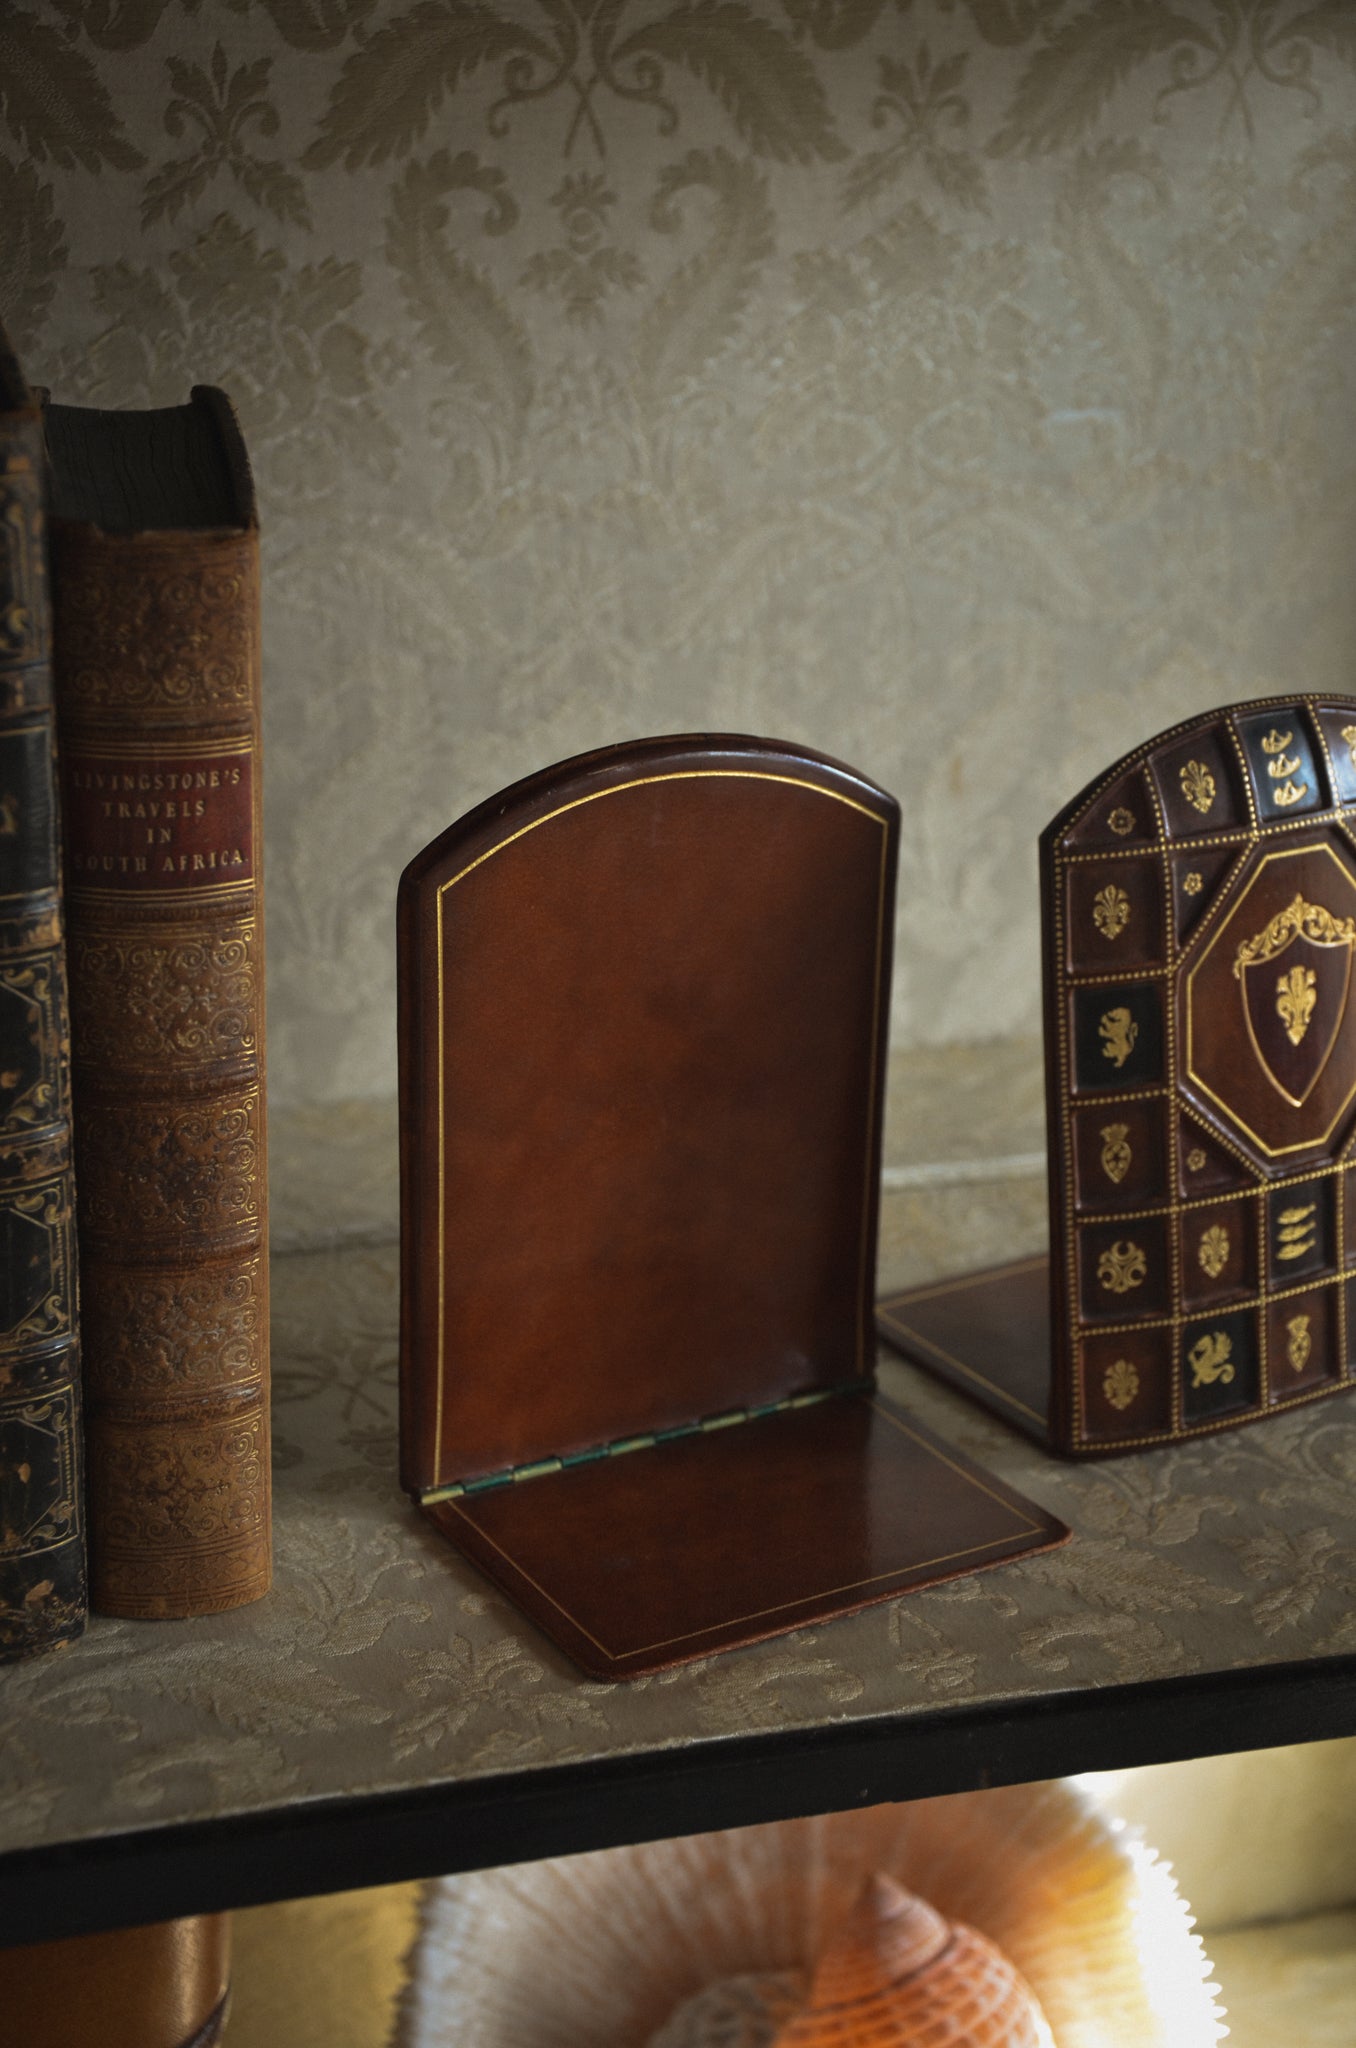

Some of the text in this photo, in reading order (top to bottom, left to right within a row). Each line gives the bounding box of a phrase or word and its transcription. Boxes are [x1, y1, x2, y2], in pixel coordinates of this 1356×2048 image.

[74, 768, 241, 791] LIVINGSTONE'S
[103, 800, 205, 818] TRAVELS
[147, 828, 173, 844] IN
[73, 855, 147, 872] SOUTH
